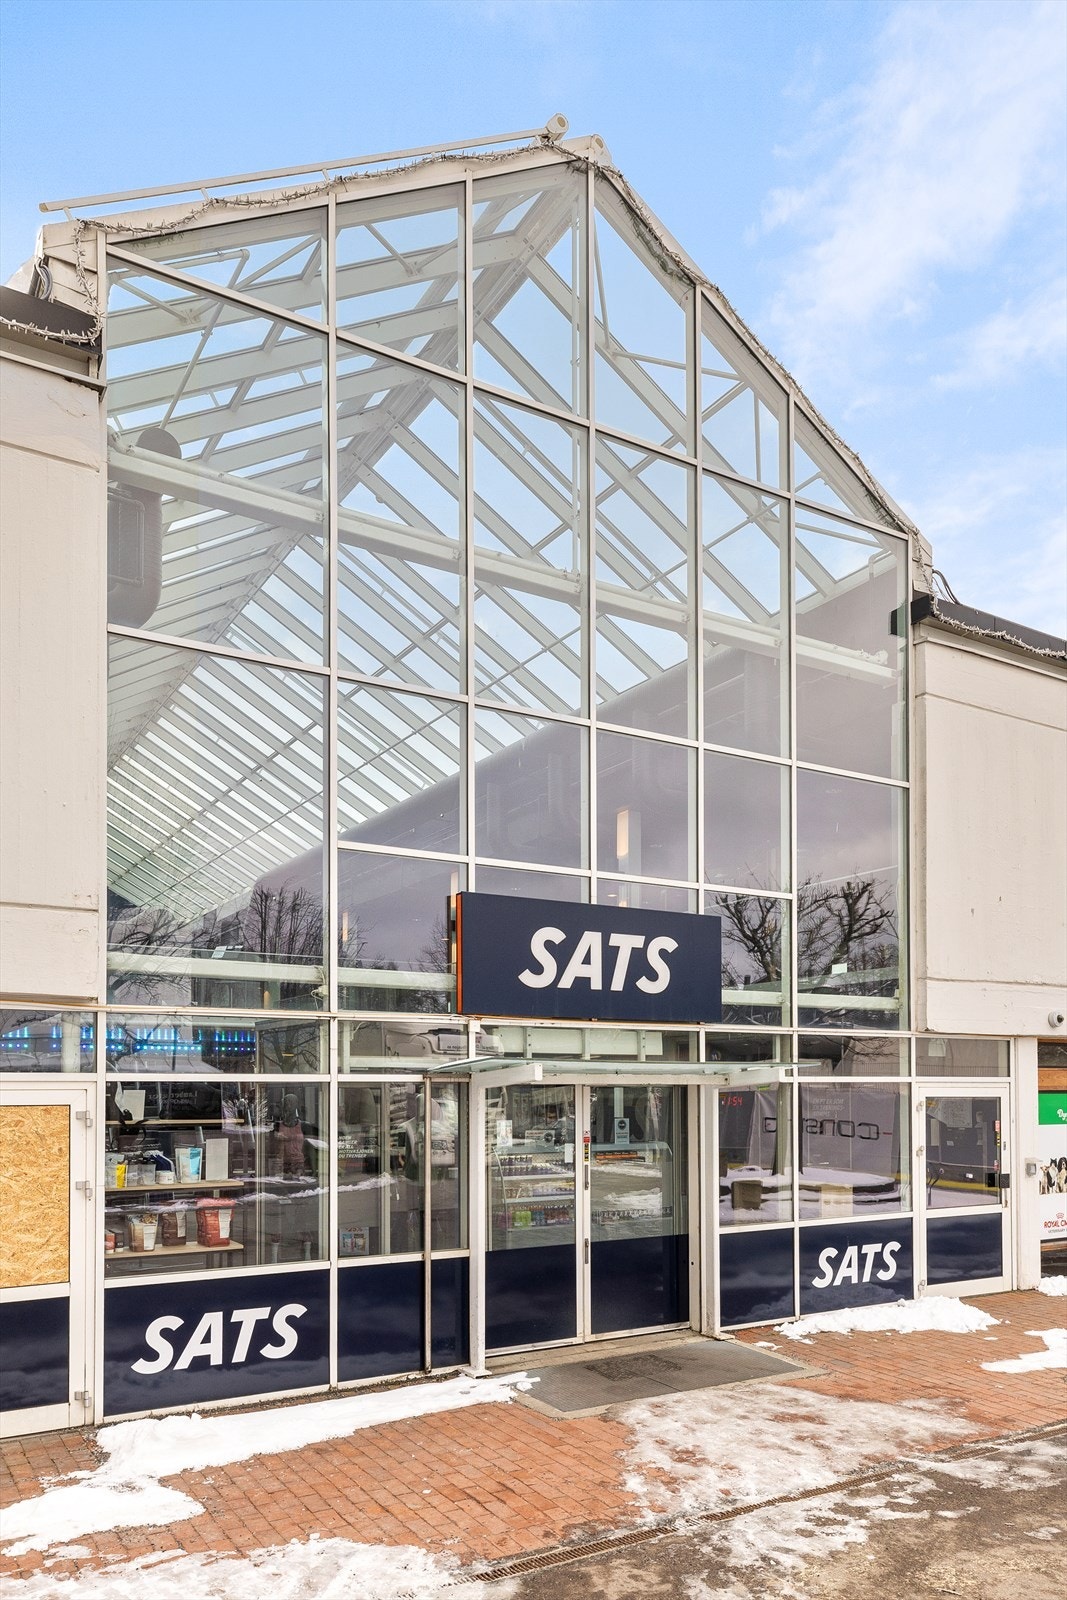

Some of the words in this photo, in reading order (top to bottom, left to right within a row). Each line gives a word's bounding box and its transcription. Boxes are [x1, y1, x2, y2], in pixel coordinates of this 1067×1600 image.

[518, 926, 679, 994] SATS
[1043, 1220, 1060, 1228] ROYAL
[812, 1240, 902, 1289] SATS
[130, 1303, 308, 1375] SATS
